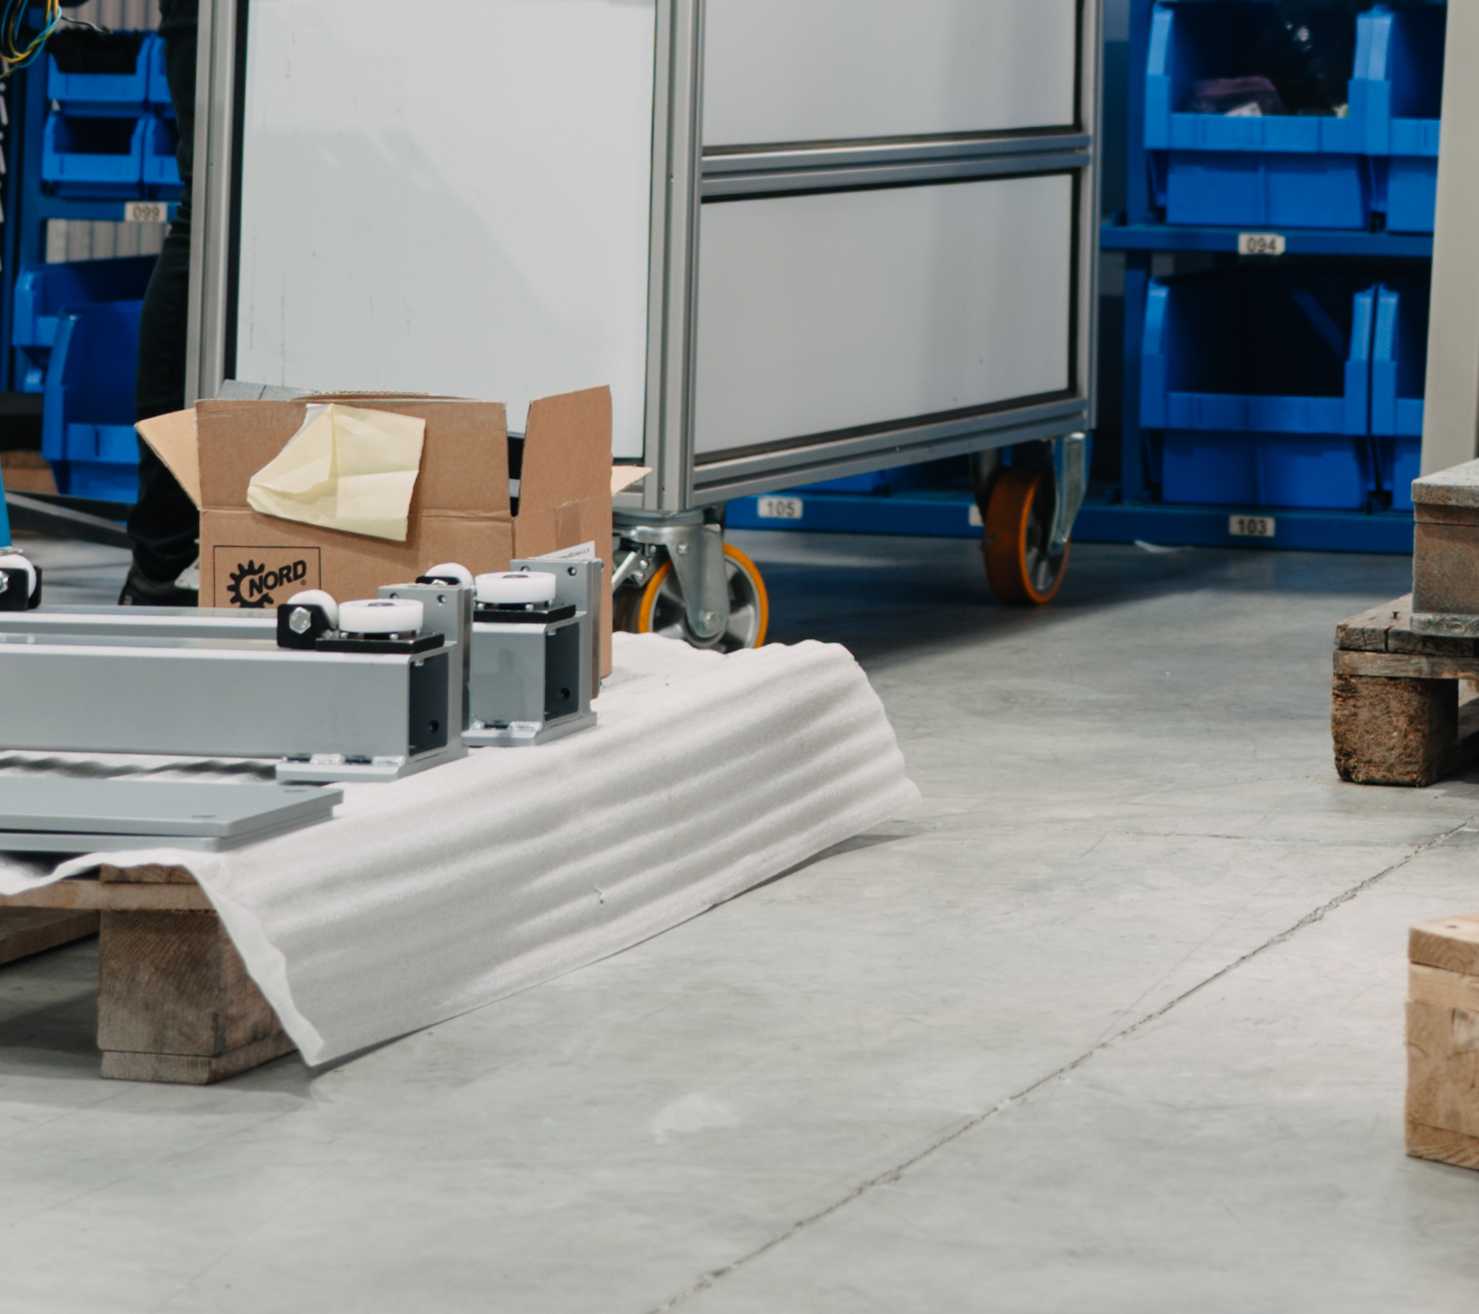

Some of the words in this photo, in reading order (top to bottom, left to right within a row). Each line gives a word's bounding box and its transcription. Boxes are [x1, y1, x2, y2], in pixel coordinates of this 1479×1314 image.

[1246, 237, 1277, 252] 094
[768, 500, 795, 515] 105
[1238, 516, 1266, 531] 103
[248, 559, 307, 597] NORD
